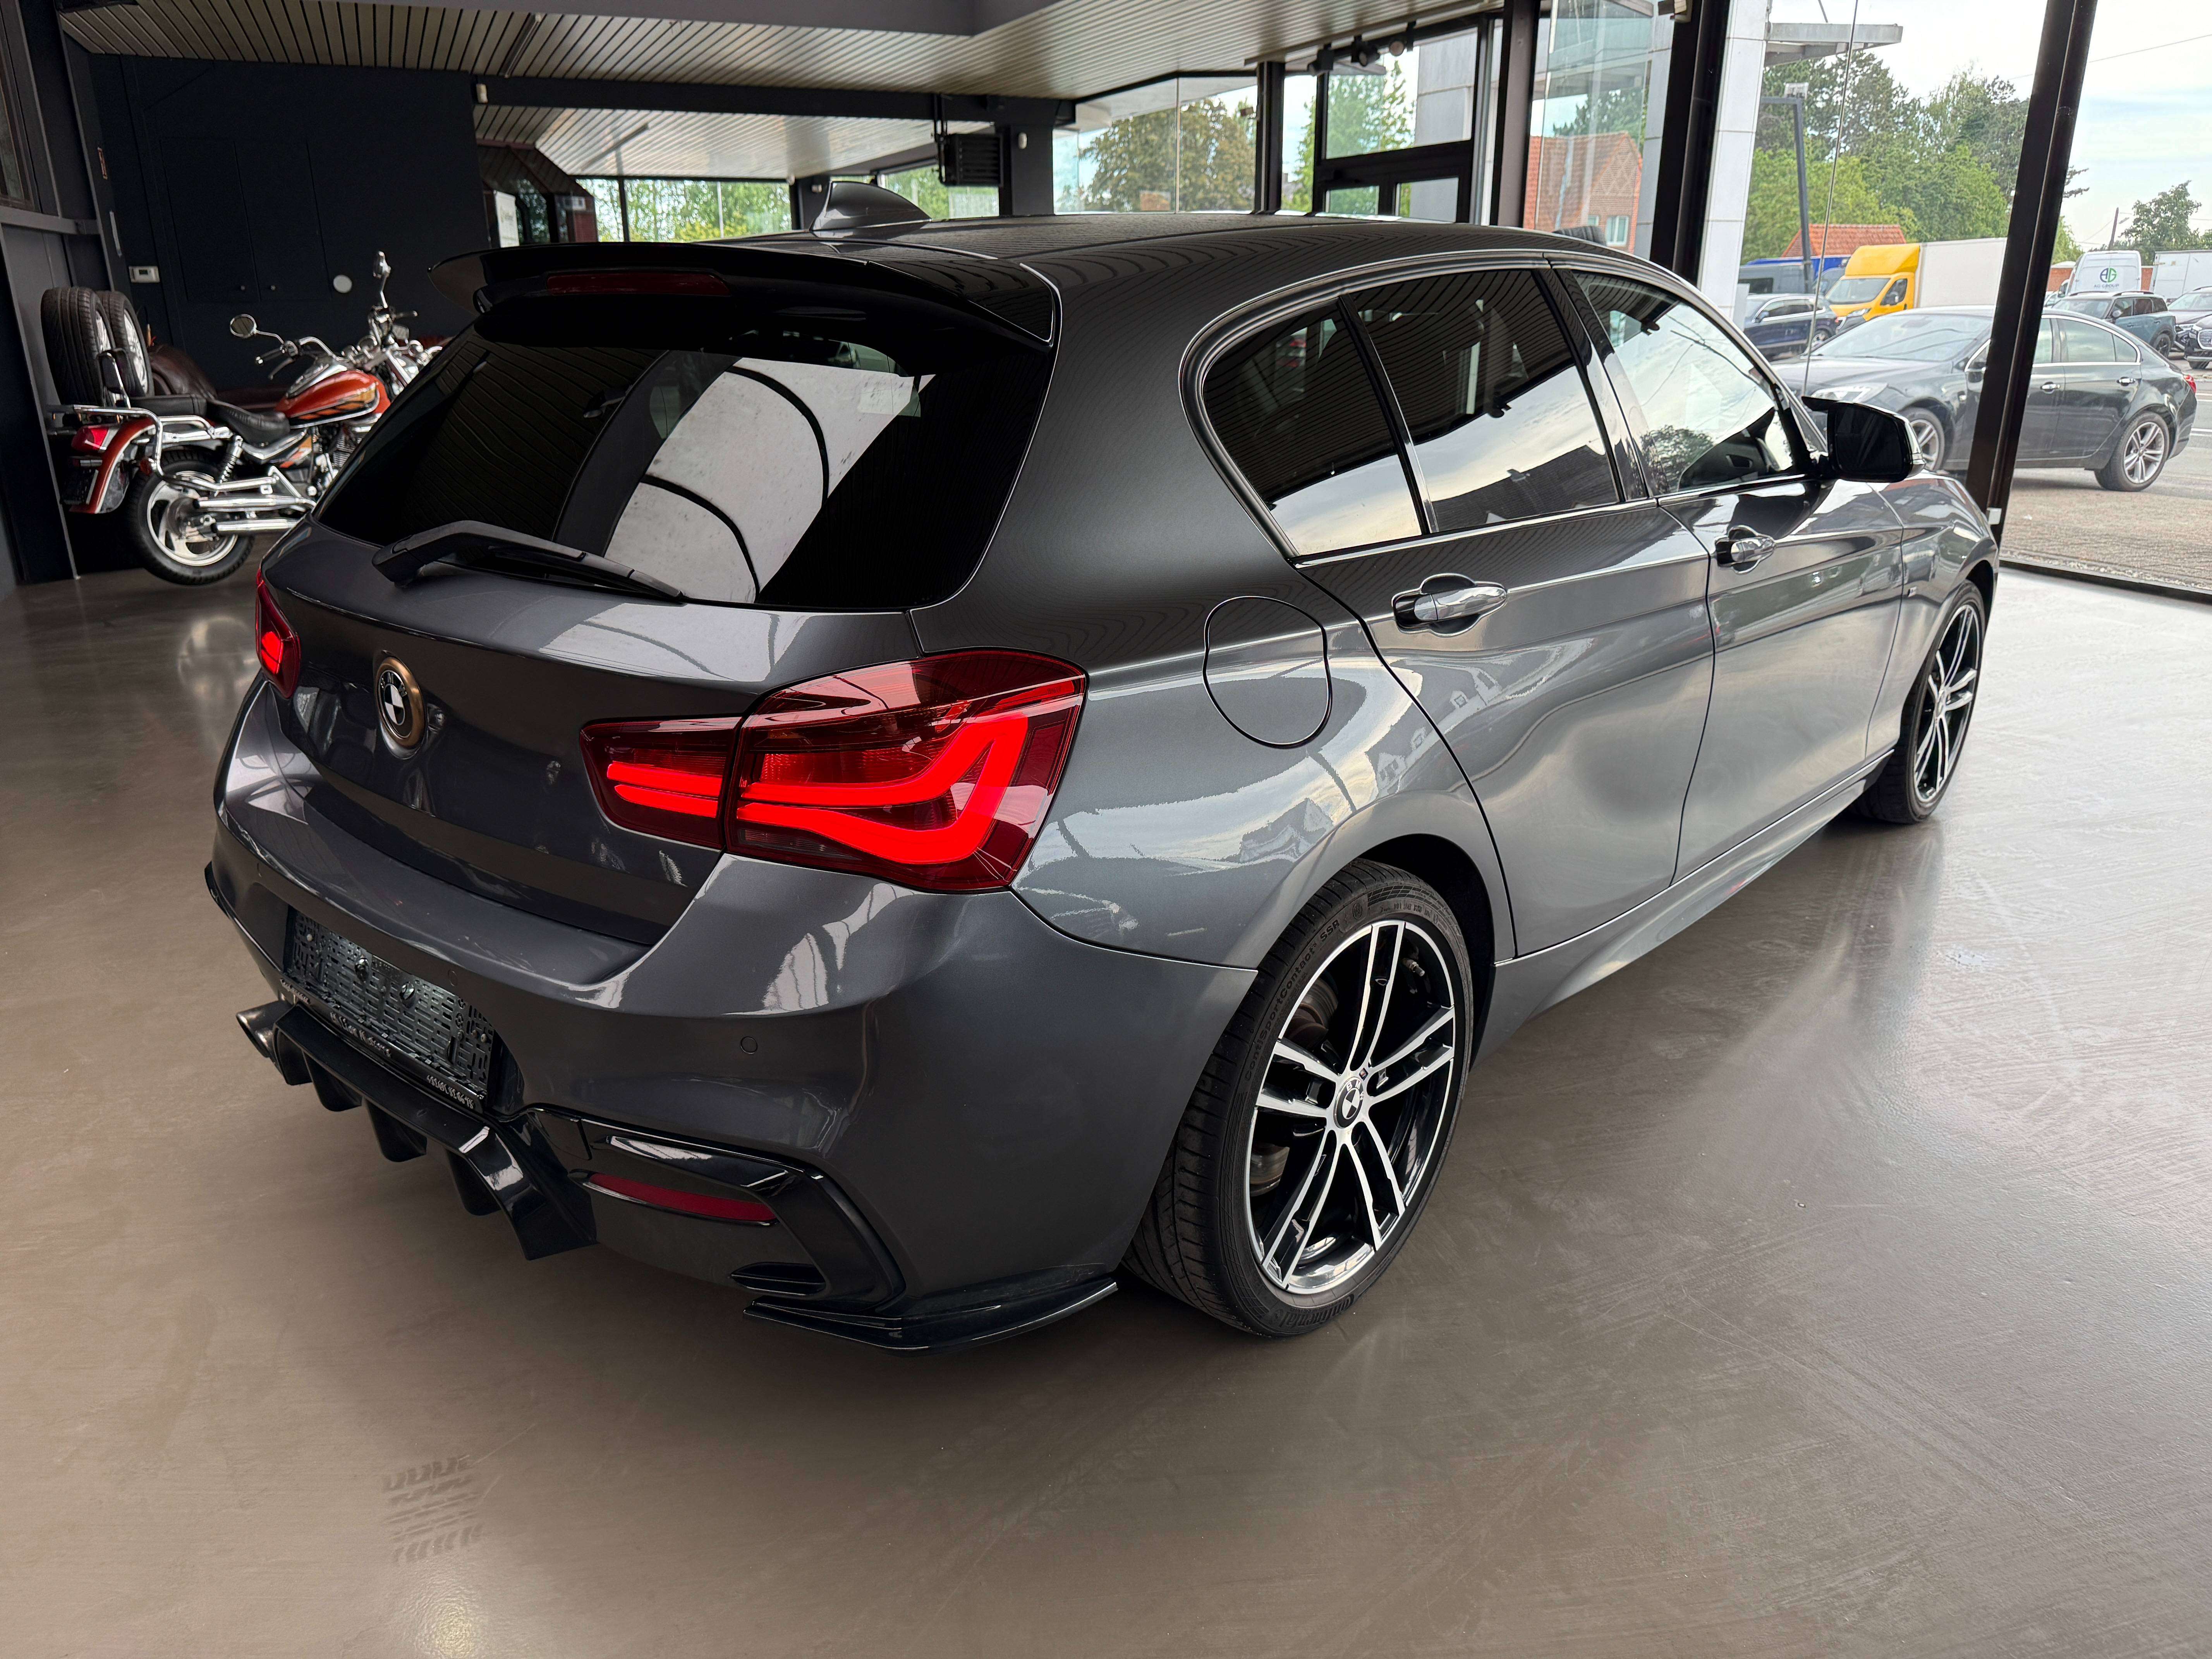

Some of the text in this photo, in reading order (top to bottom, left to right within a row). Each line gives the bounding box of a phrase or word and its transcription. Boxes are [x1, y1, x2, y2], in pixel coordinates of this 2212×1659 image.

[380, 672, 407, 697] BMW
[1320, 919, 1340, 942] SSR
[1346, 1080, 1364, 1101] BMW
